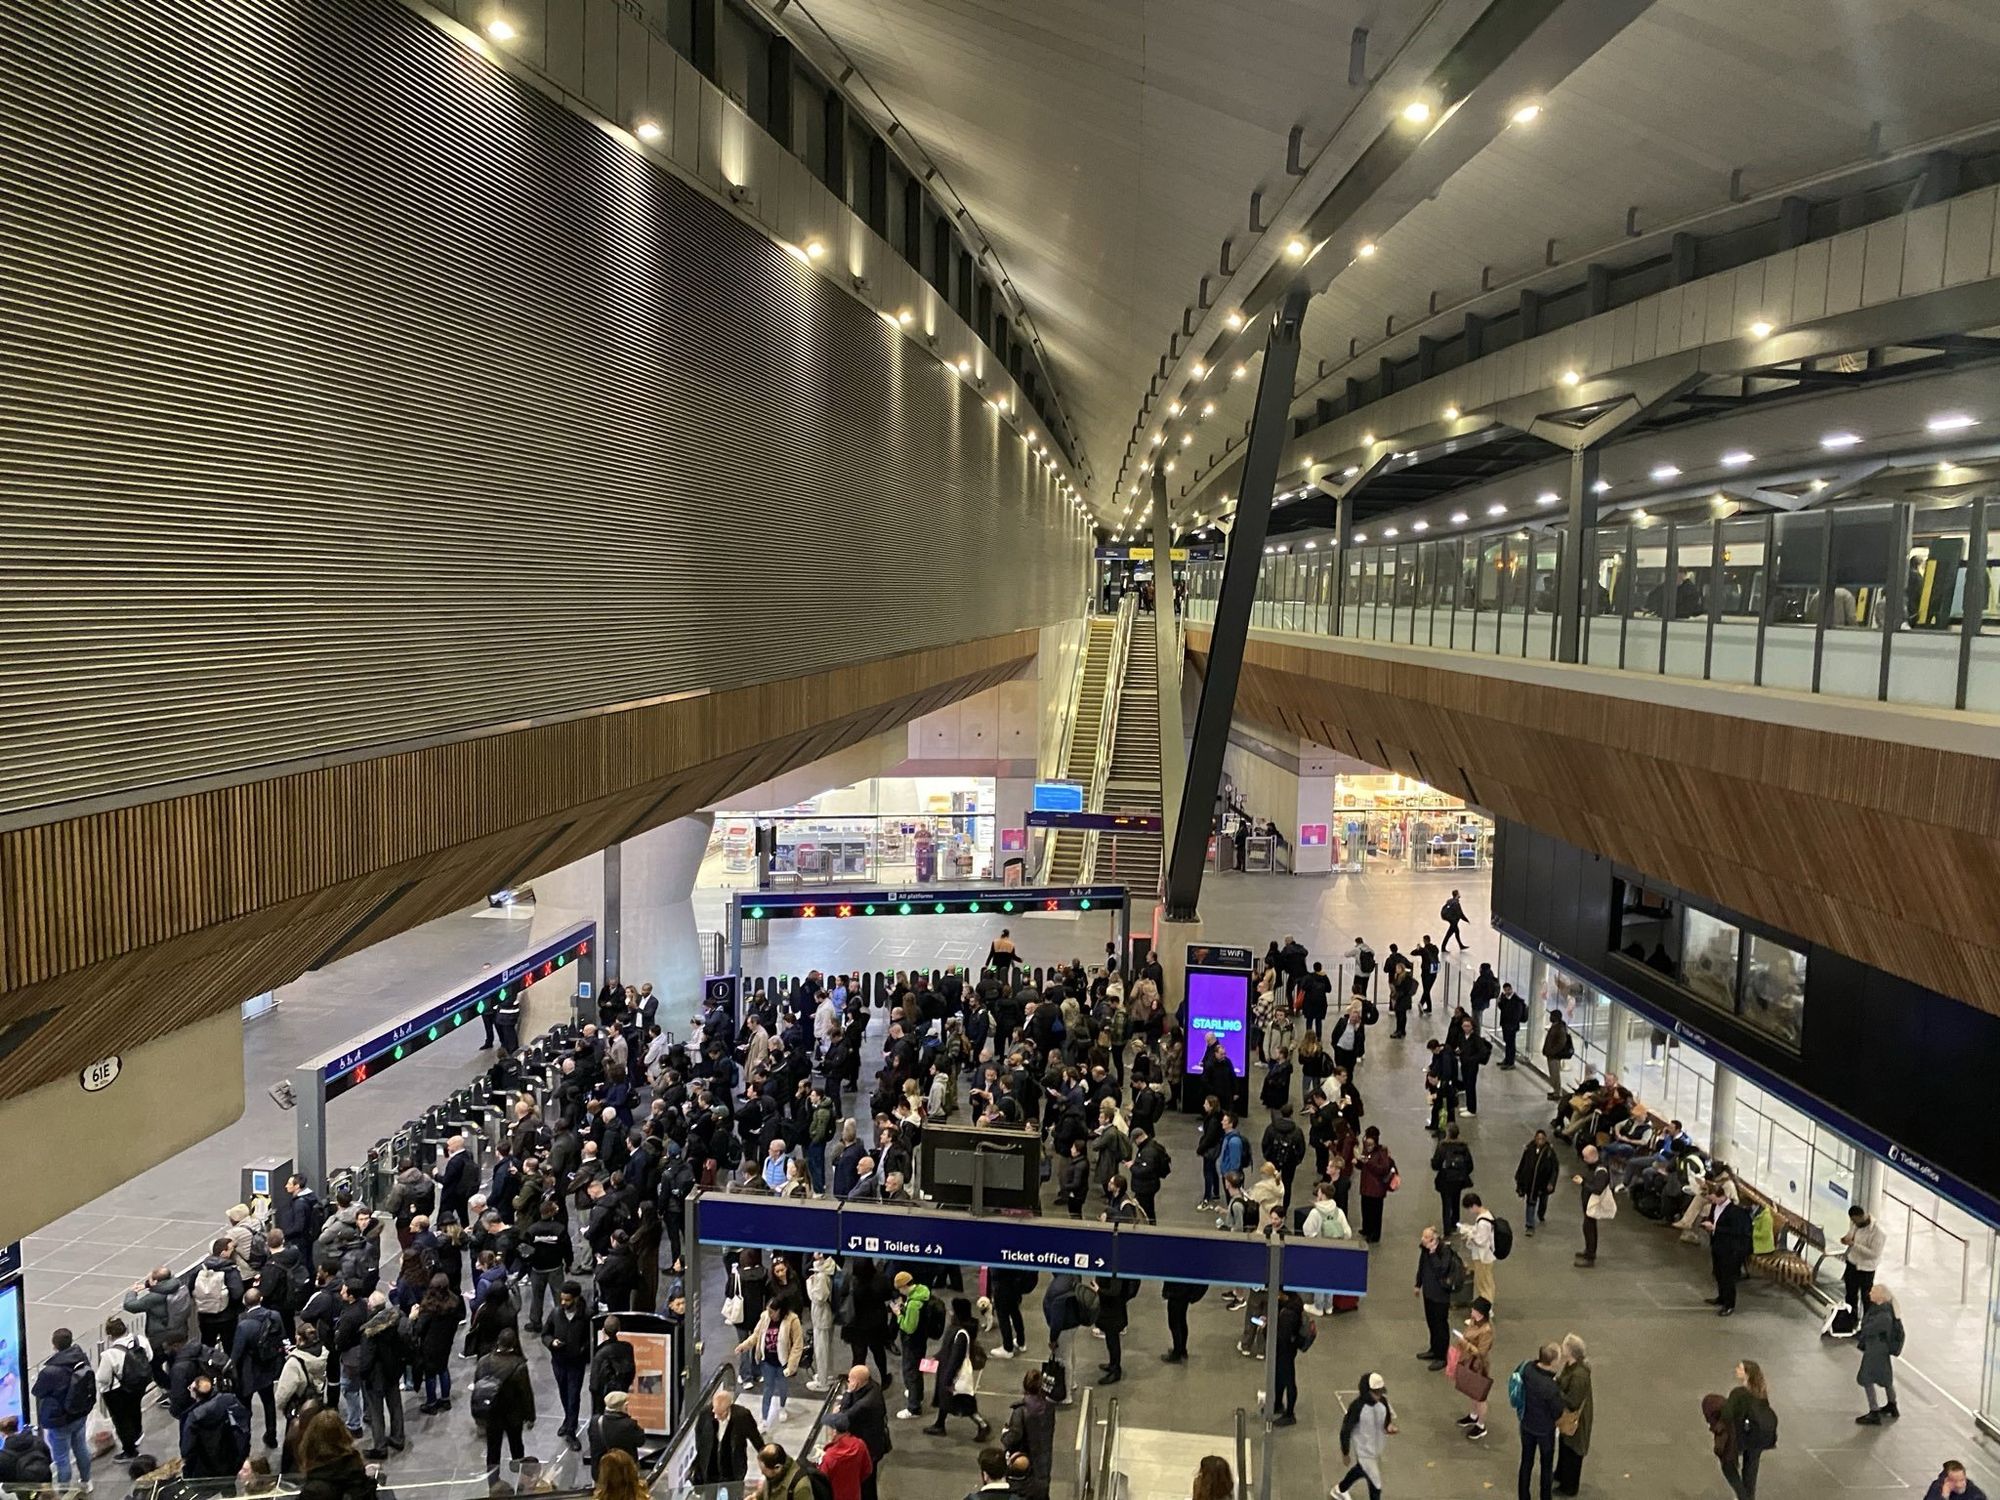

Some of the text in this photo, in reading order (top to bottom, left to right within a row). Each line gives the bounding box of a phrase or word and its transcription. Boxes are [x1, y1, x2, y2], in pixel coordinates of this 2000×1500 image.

[1193, 1017, 1242, 1031] STARLING
[1901, 1152, 1940, 1182] Ticket office
[884, 1240, 920, 1253] Toilets
[1001, 1250, 1070, 1265] Ticket office
